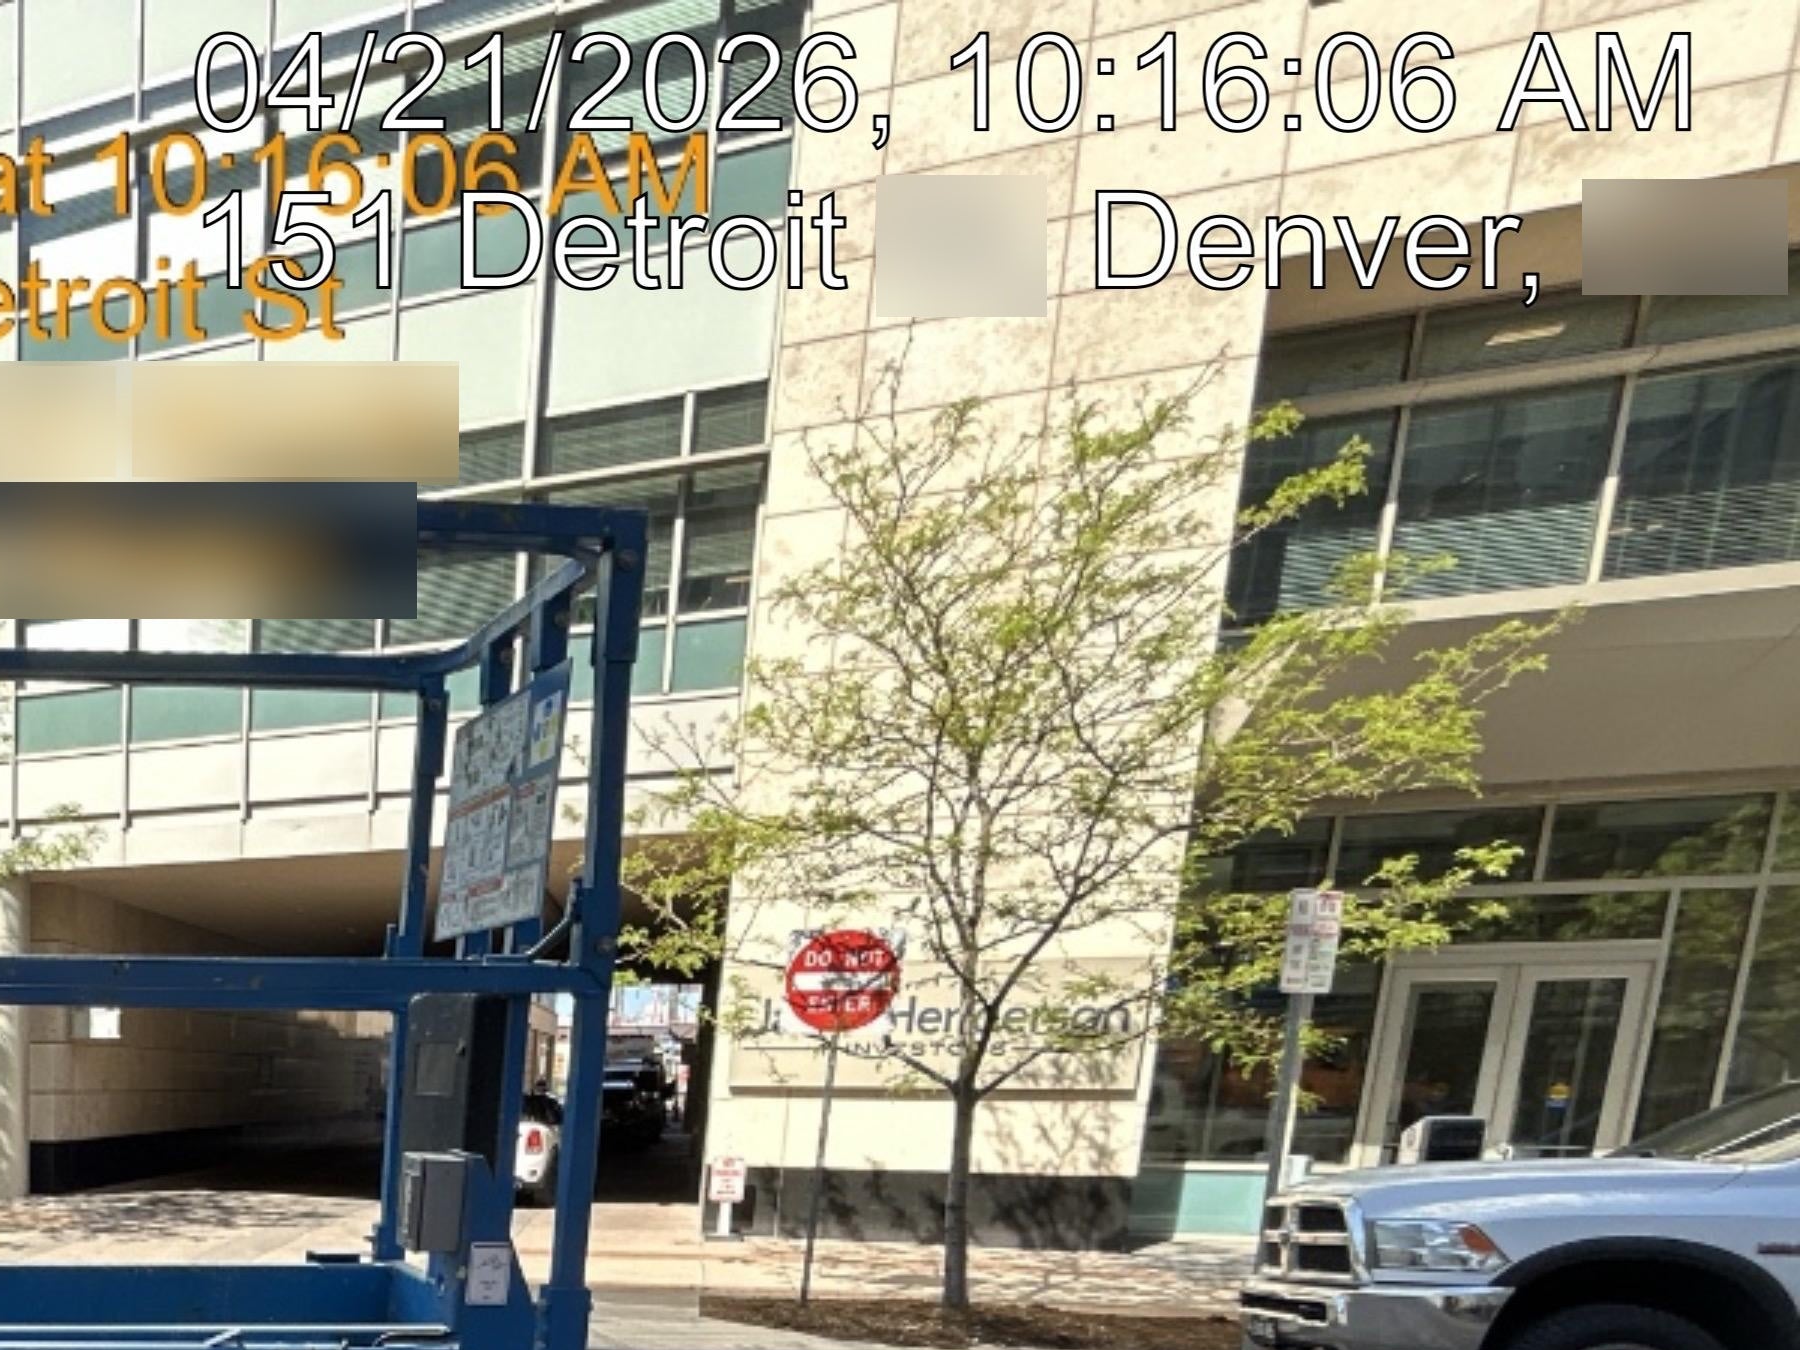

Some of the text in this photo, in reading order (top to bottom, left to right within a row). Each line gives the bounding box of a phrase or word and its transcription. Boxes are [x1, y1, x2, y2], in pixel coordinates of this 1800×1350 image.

[805, 951, 886, 967] DO NOT
[888, 995, 1130, 1035] Henerson
[845, 1041, 1006, 1057] INVESTOS
